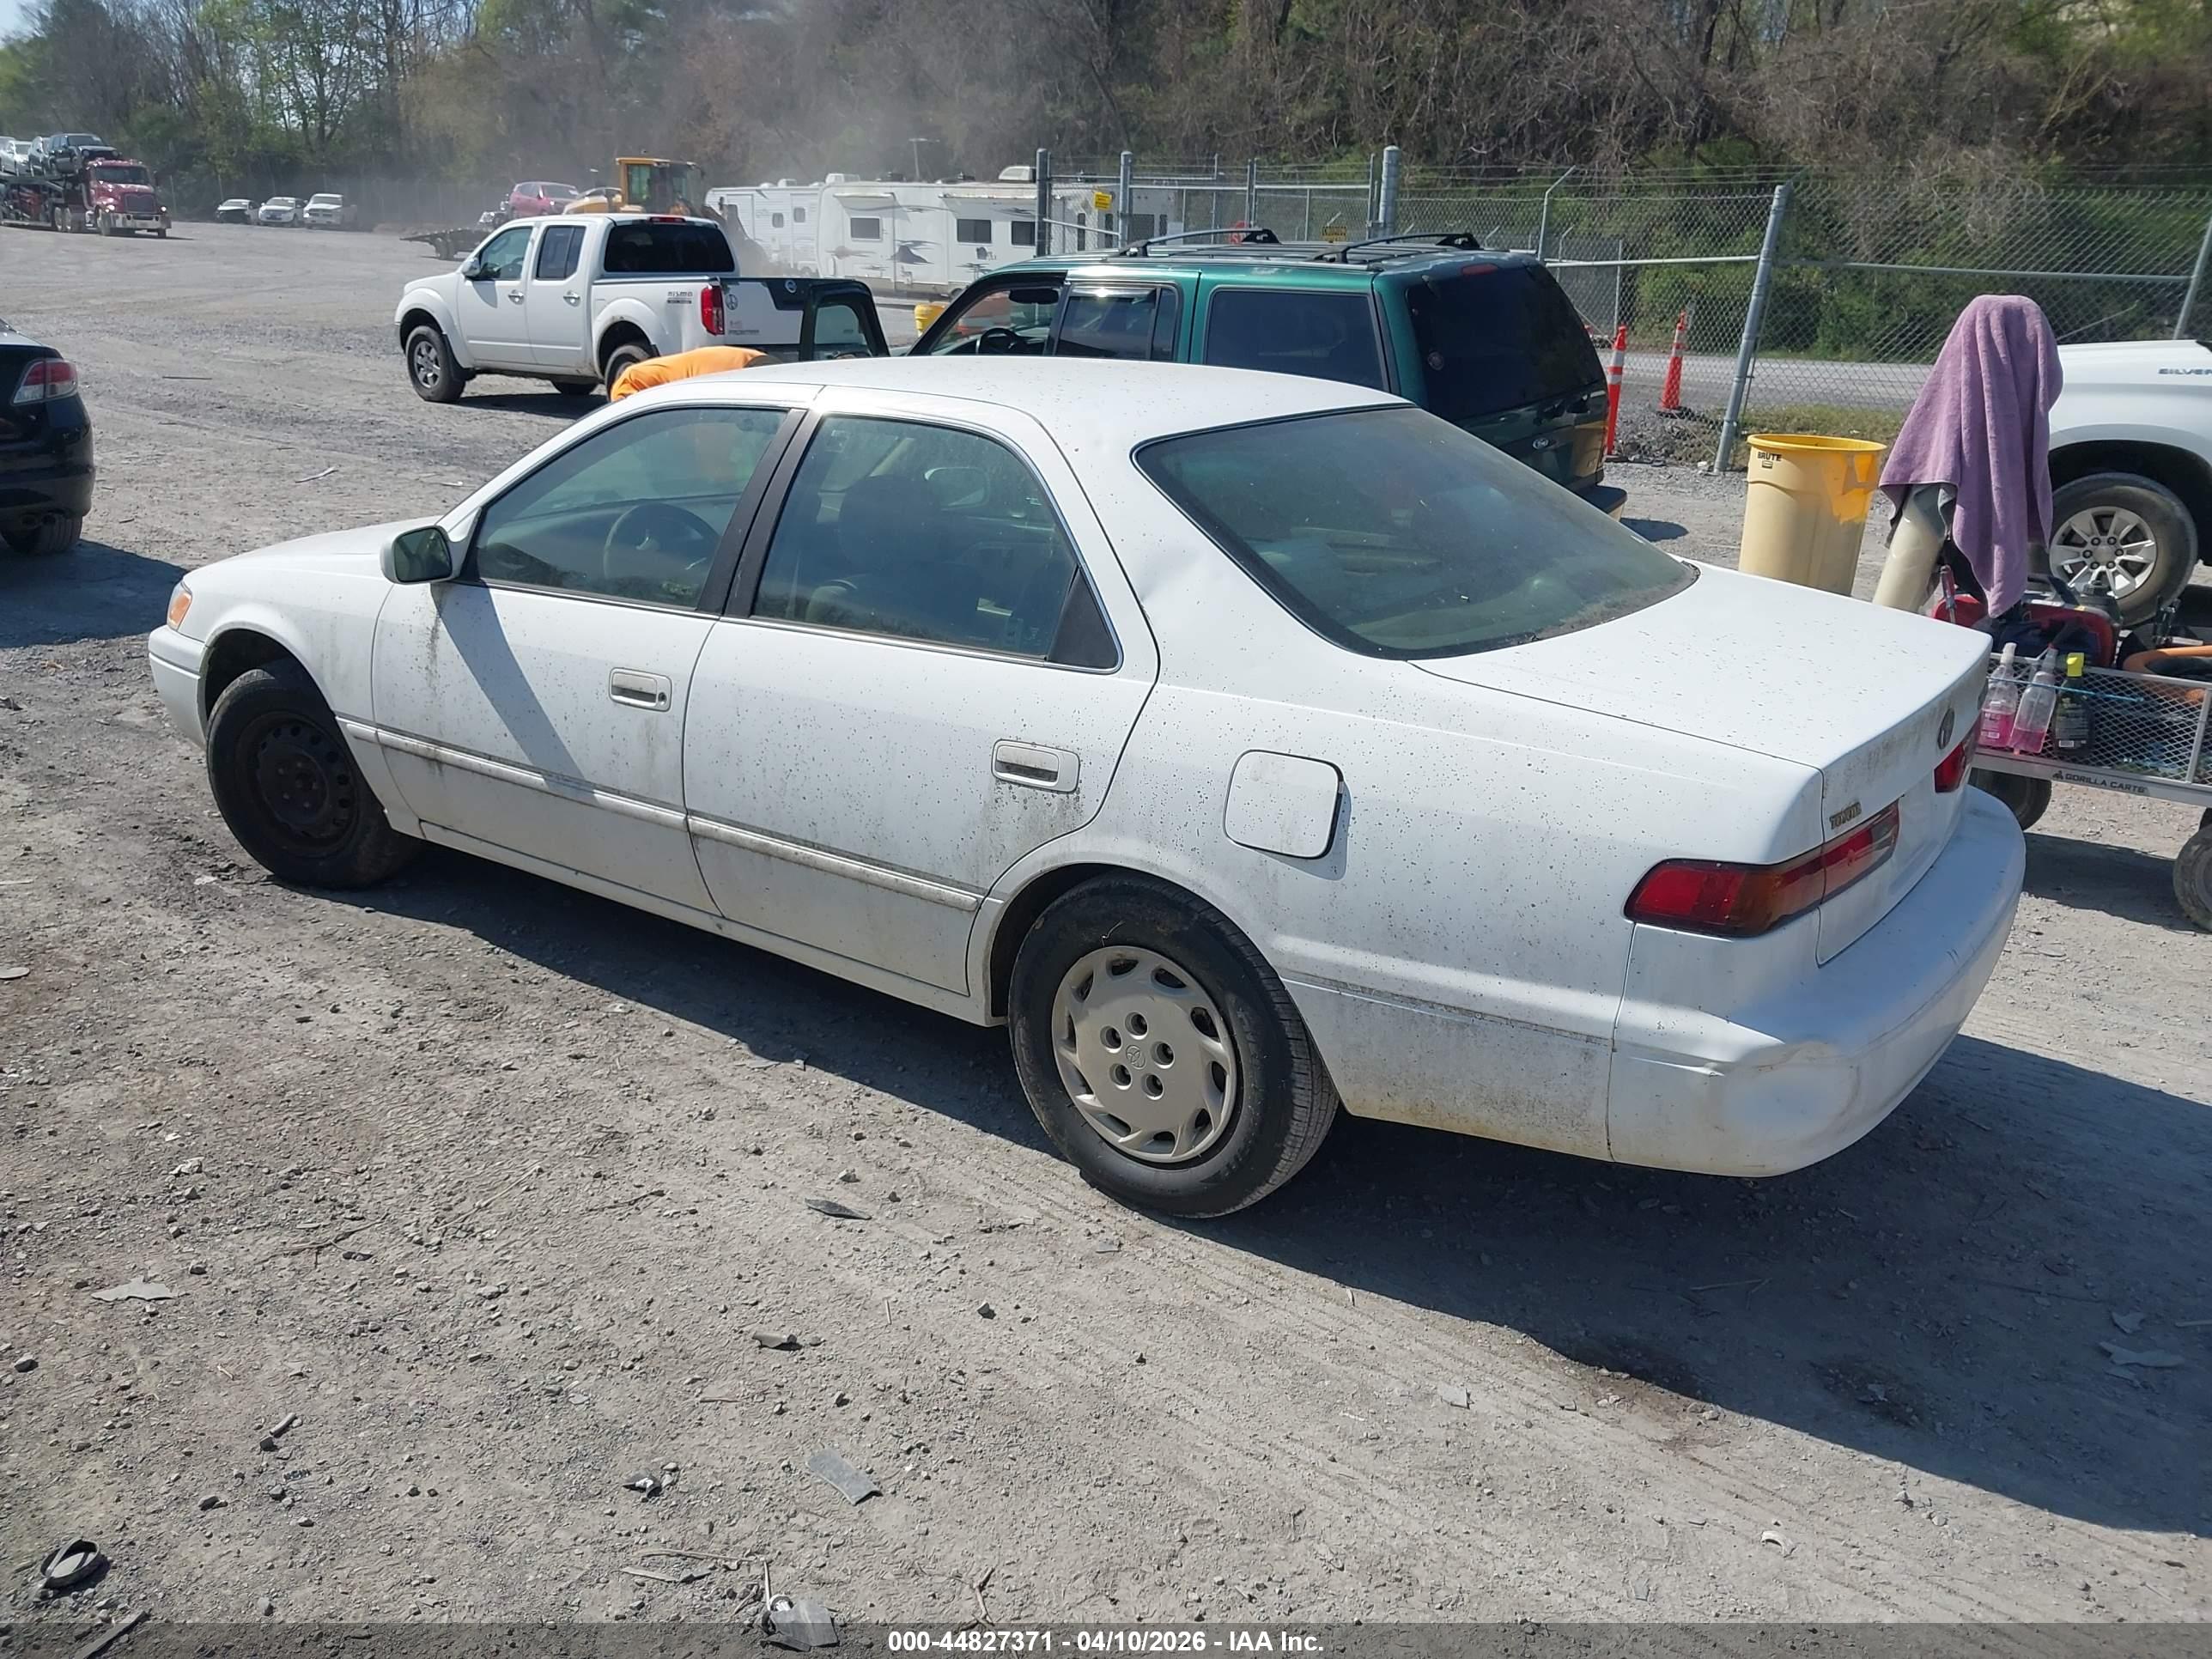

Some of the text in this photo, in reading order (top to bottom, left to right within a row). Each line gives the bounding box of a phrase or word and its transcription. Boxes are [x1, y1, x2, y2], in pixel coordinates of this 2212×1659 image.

[1757, 451, 1783, 462] BRUTE
[2065, 773, 2147, 793] GORILLA CARTS
